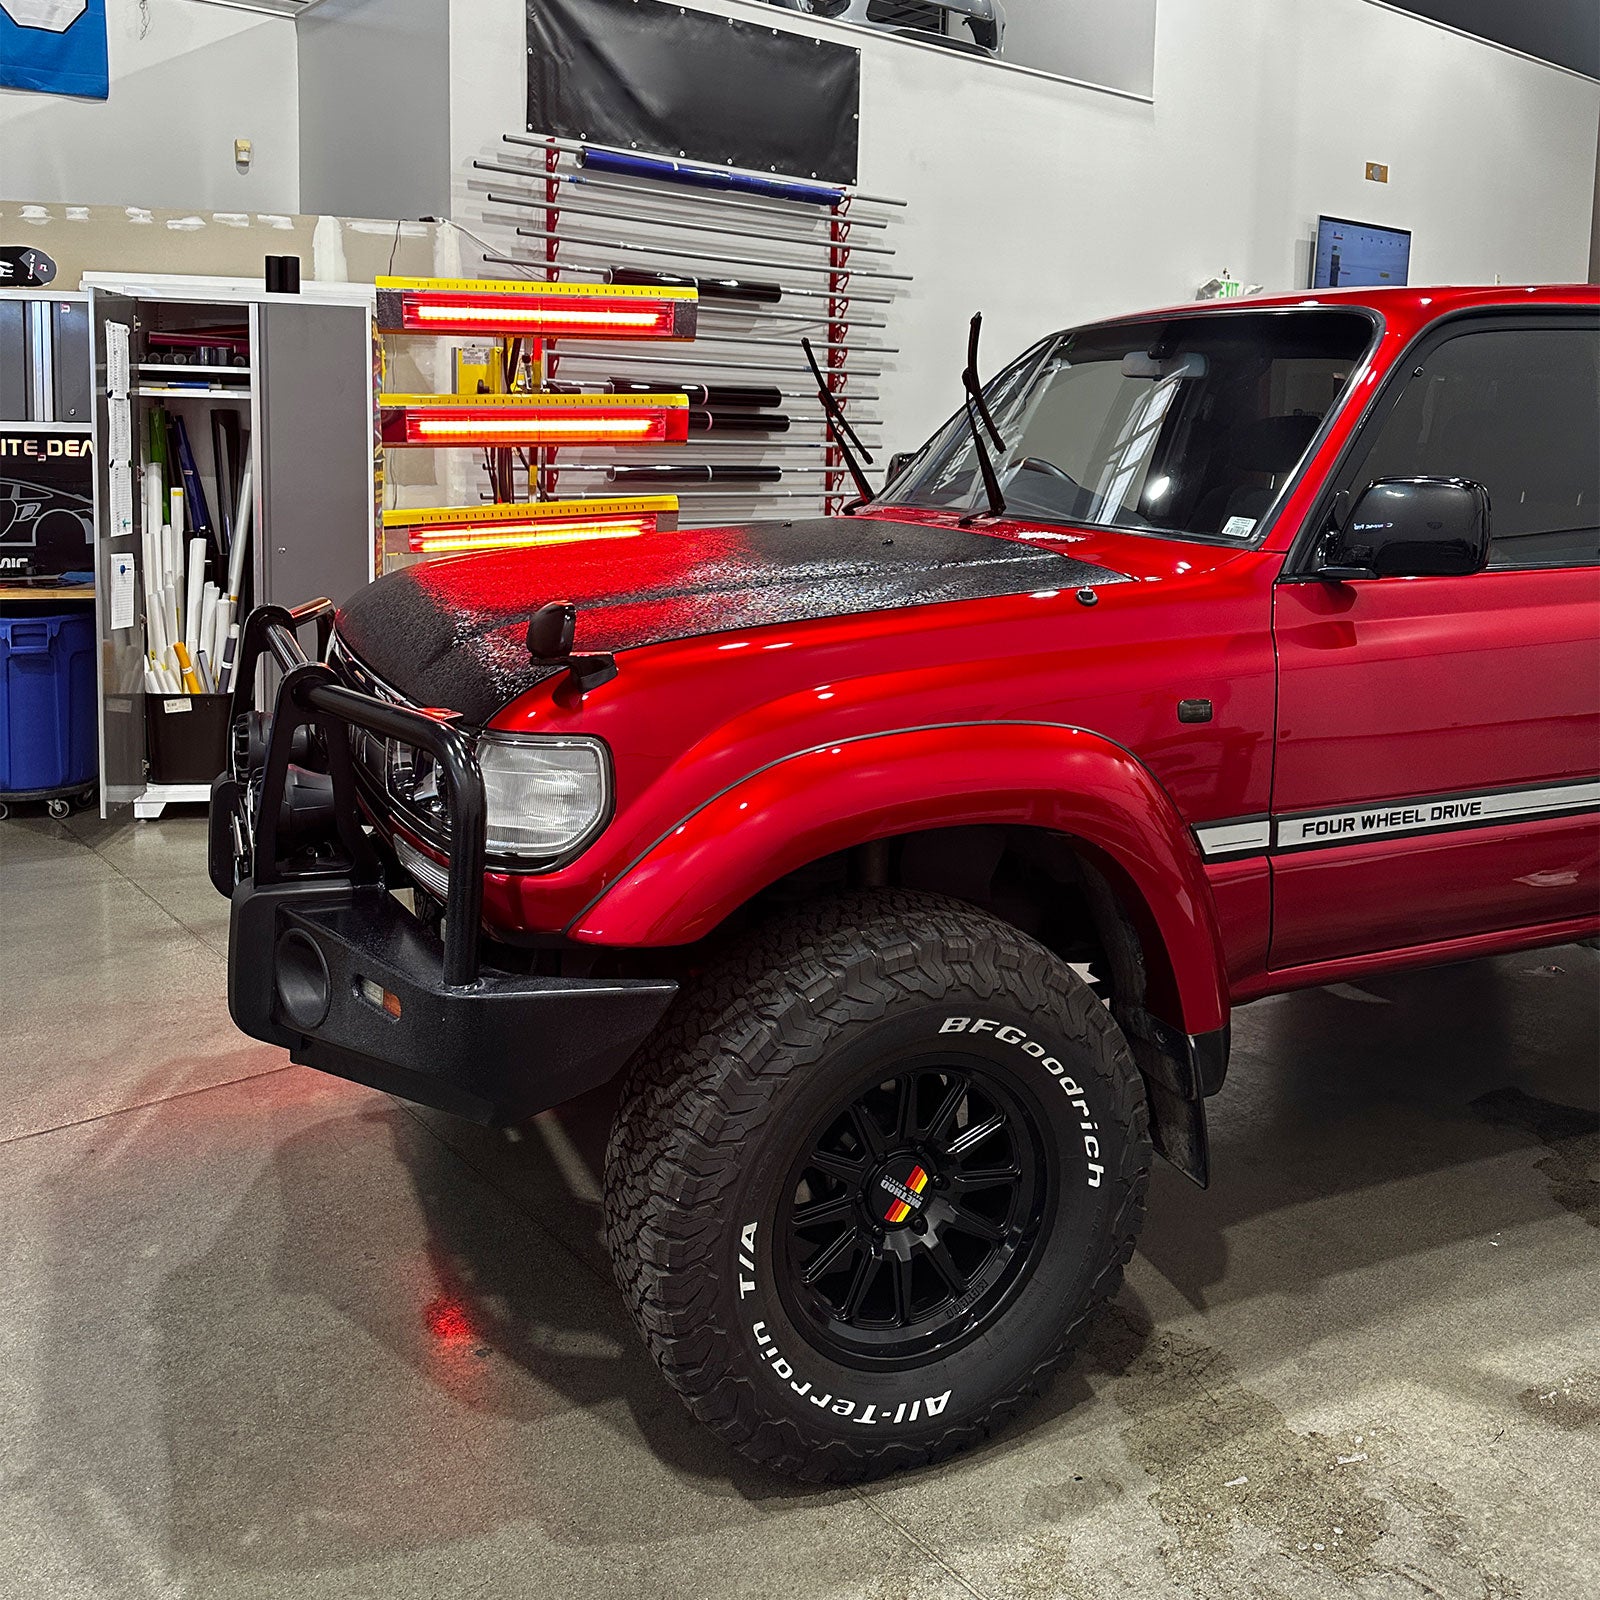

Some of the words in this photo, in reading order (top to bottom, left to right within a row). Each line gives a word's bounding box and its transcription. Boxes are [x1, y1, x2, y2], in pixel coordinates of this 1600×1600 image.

[1302, 817, 1355, 838] FOUR
[1361, 809, 1426, 829] WHEEL
[1431, 802, 1482, 821] DRIVE
[938, 1017, 1104, 1188] BFGoodrich
[880, 1180, 922, 1209] METHOD
[739, 1222, 758, 1300] T/A
[752, 1321, 952, 1425] All-Terrain
